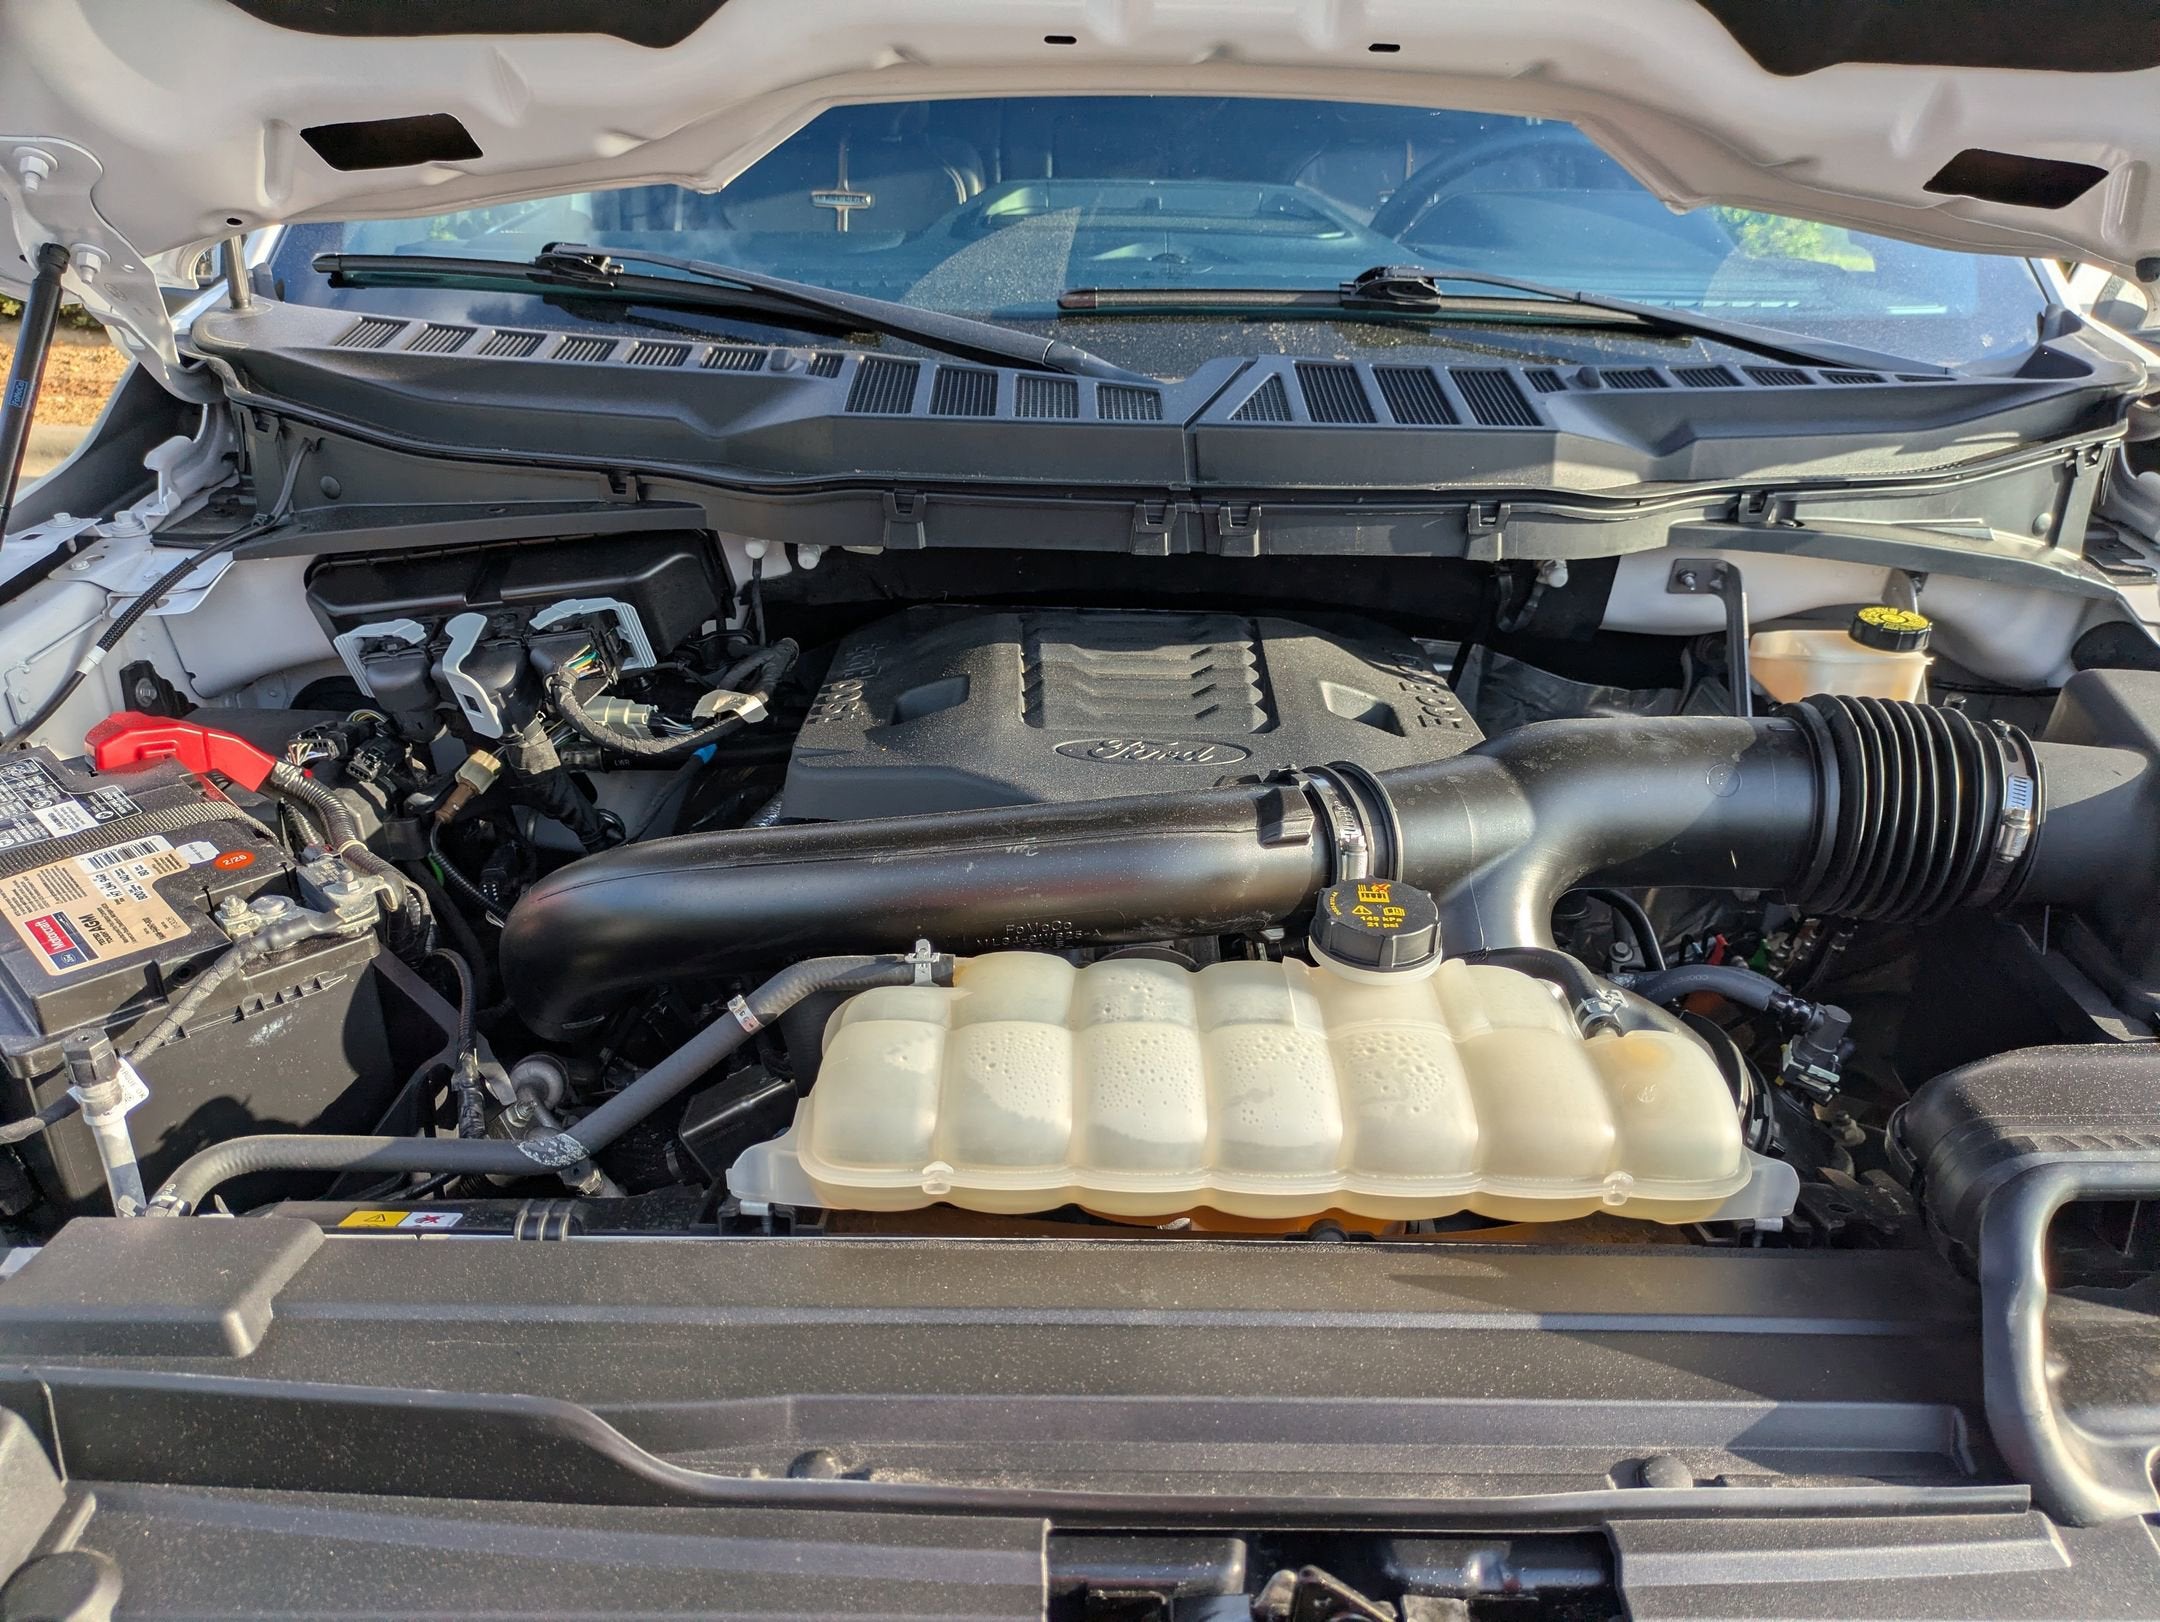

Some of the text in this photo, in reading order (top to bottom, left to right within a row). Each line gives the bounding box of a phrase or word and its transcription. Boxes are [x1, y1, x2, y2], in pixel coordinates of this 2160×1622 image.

[1087, 737, 1216, 763] Ford
[222, 854, 248, 867] 2/26
[78, 913, 105, 933] AGM
[1006, 920, 1072, 936] FoMoCo
[1383, 922, 1399, 930] psi
[34, 919, 66, 950] Motorcraft
